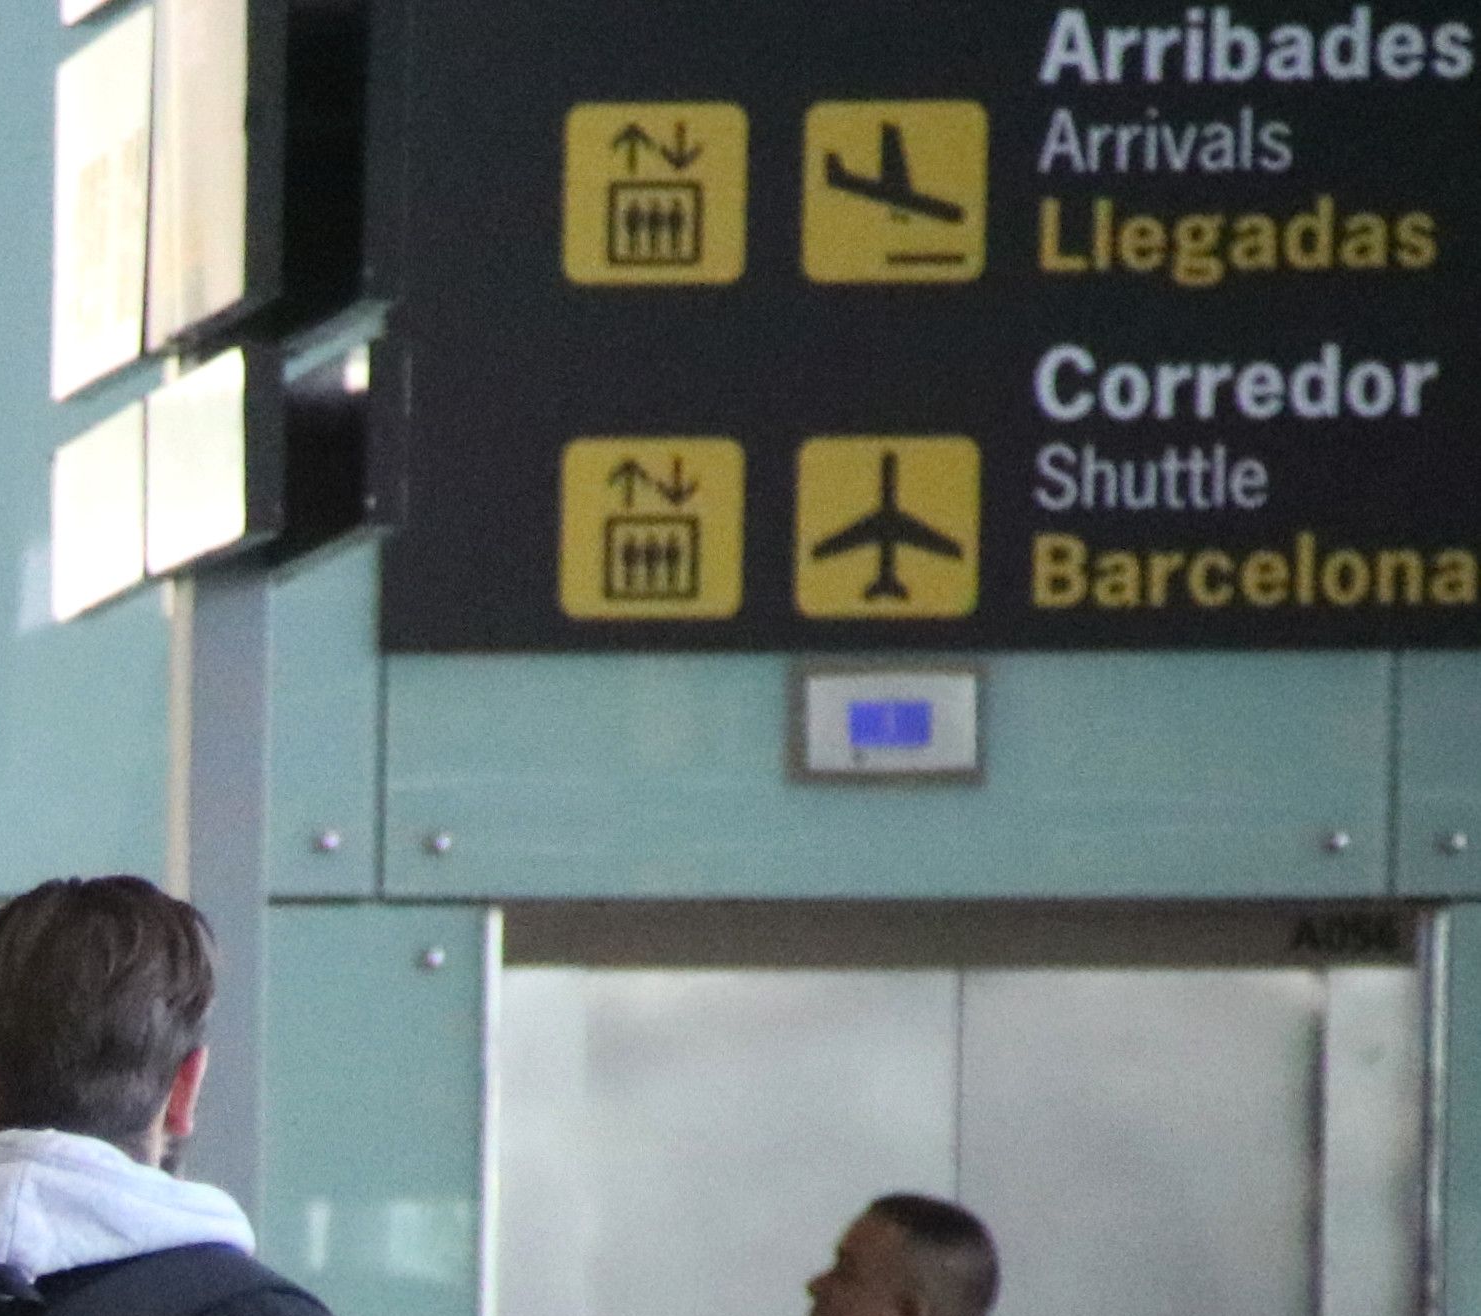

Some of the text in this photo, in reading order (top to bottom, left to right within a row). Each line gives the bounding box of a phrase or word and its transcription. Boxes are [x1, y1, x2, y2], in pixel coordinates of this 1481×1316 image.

[1038, 5, 1475, 83] Arribades
[1037, 106, 1294, 173] Arrivals
[1039, 194, 1438, 287] Llegadas
[1034, 342, 1440, 422] Corredor
[1032, 442, 1269, 511] Shuttle
[1031, 530, 1481, 608] Barcelona
